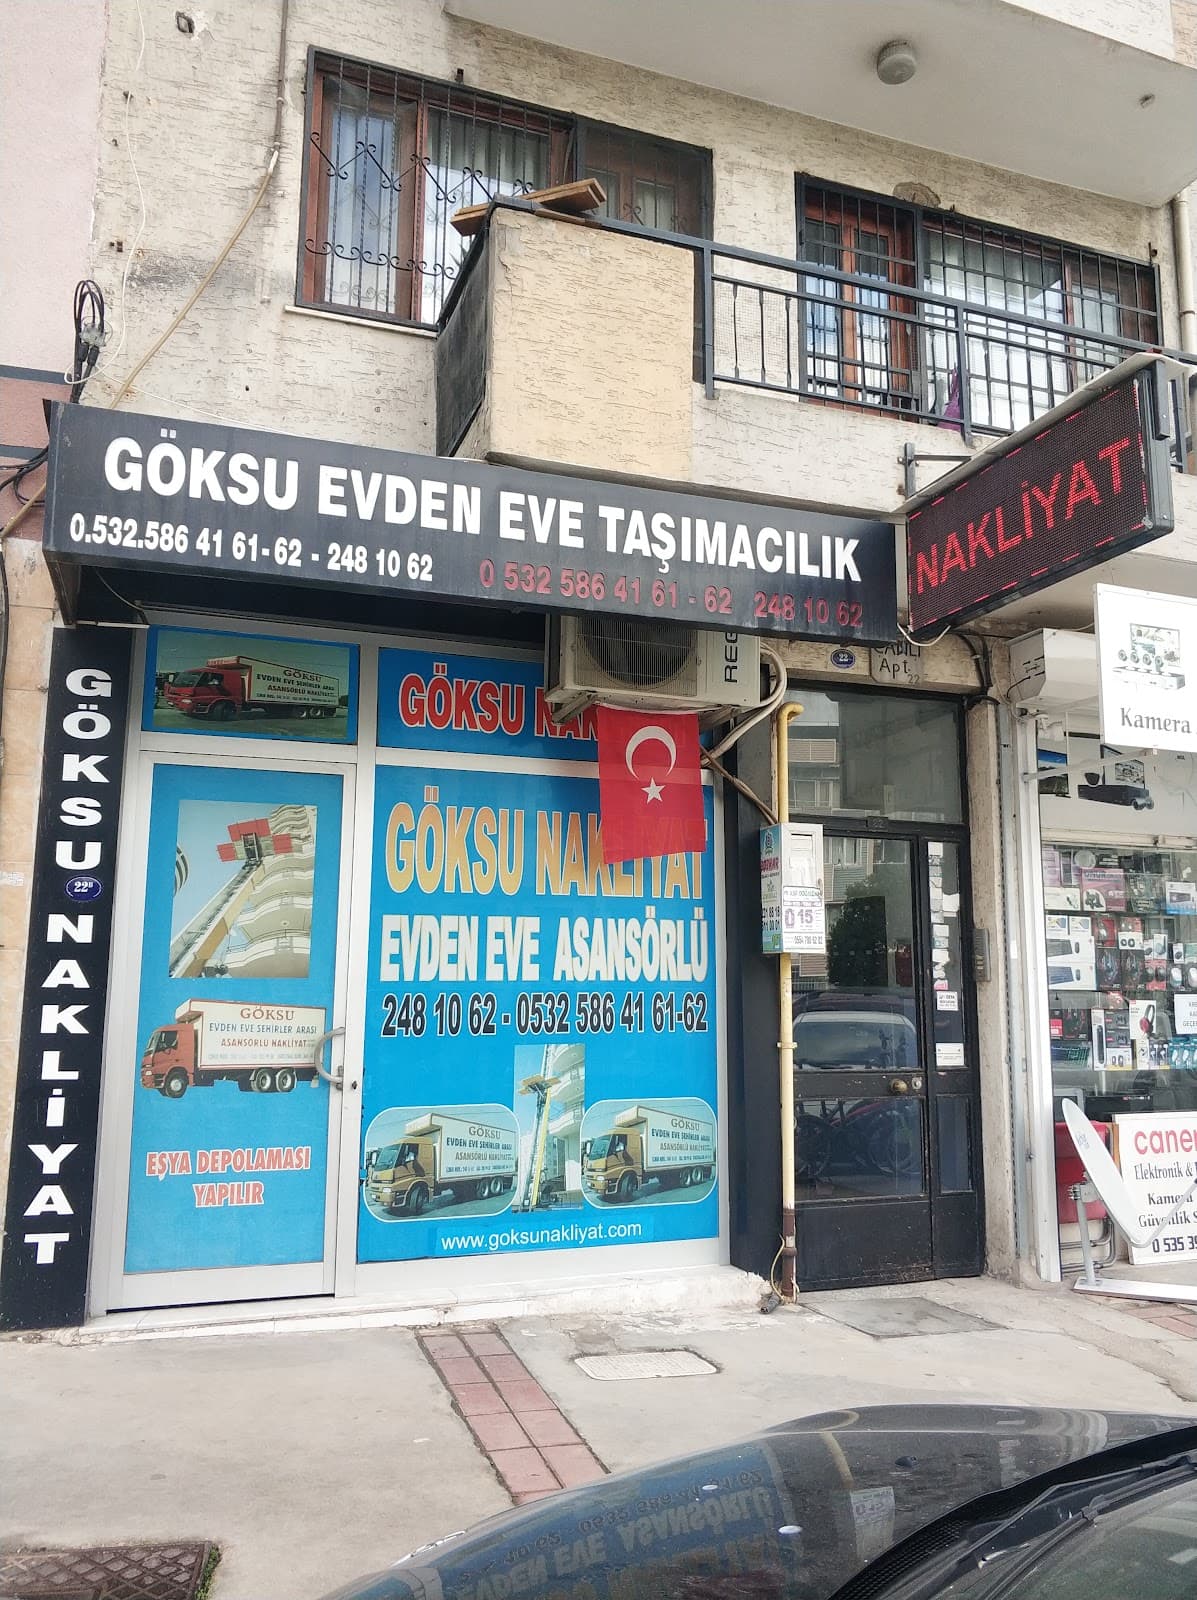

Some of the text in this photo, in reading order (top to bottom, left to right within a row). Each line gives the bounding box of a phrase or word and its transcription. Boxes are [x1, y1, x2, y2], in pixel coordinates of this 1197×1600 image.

[105, 428, 862, 582] GÖKSU EVDEN EVE TAŞIMACILIK
[916, 437, 1130, 594] NAKLİYAT
[70, 512, 188, 554] 0.532.586
[196, 527, 222, 557] 41
[327, 543, 368, 574] 248
[376, 549, 400, 578] 10
[407, 552, 433, 581] 62
[479, 559, 495, 588] 0
[504, 562, 552, 594] 532
[560, 569, 605, 600] 586
[614, 575, 641, 604] 41
[651, 579, 678, 608] 61
[704, 585, 732, 614] 62
[753, 591, 795, 621] 248
[805, 597, 829, 624] 10
[836, 601, 863, 628] 62
[399, 662, 525, 735] GÖKSU
[1120, 707, 1192, 734] Kamera
[56, 668, 112, 871] GÖKSU
[385, 785, 525, 896] GÖKSU
[380, 905, 708, 983] EVDEN EVE ASANSÖRLÜ
[209, 1022, 237, 1032] EVDEN
[240, 1023, 254, 1033] EVE
[240, 1006, 295, 1021] GÖKSU
[381, 993, 426, 1038] 248
[433, 992, 462, 1037] 10
[468, 992, 496, 1036] 62
[516, 992, 570, 1036] 0532
[575, 991, 615, 1035] 586
[620, 991, 644, 1034] 41
[468, 1125, 501, 1139] GÖKSU
[146, 1146, 312, 1181] EŞYA DEPOLAMASI
[1134, 1161, 1184, 1180] Elektronik
[1185, 1161, 1193, 1177] &
[192, 1181, 265, 1208] YAPILIR
[1147, 1192, 1193, 1206] Kamea
[441, 1220, 642, 1251] www.goksunakliyat.com
[1152, 1238, 1160, 1253] 0
[1163, 1236, 1185, 1252] 535
